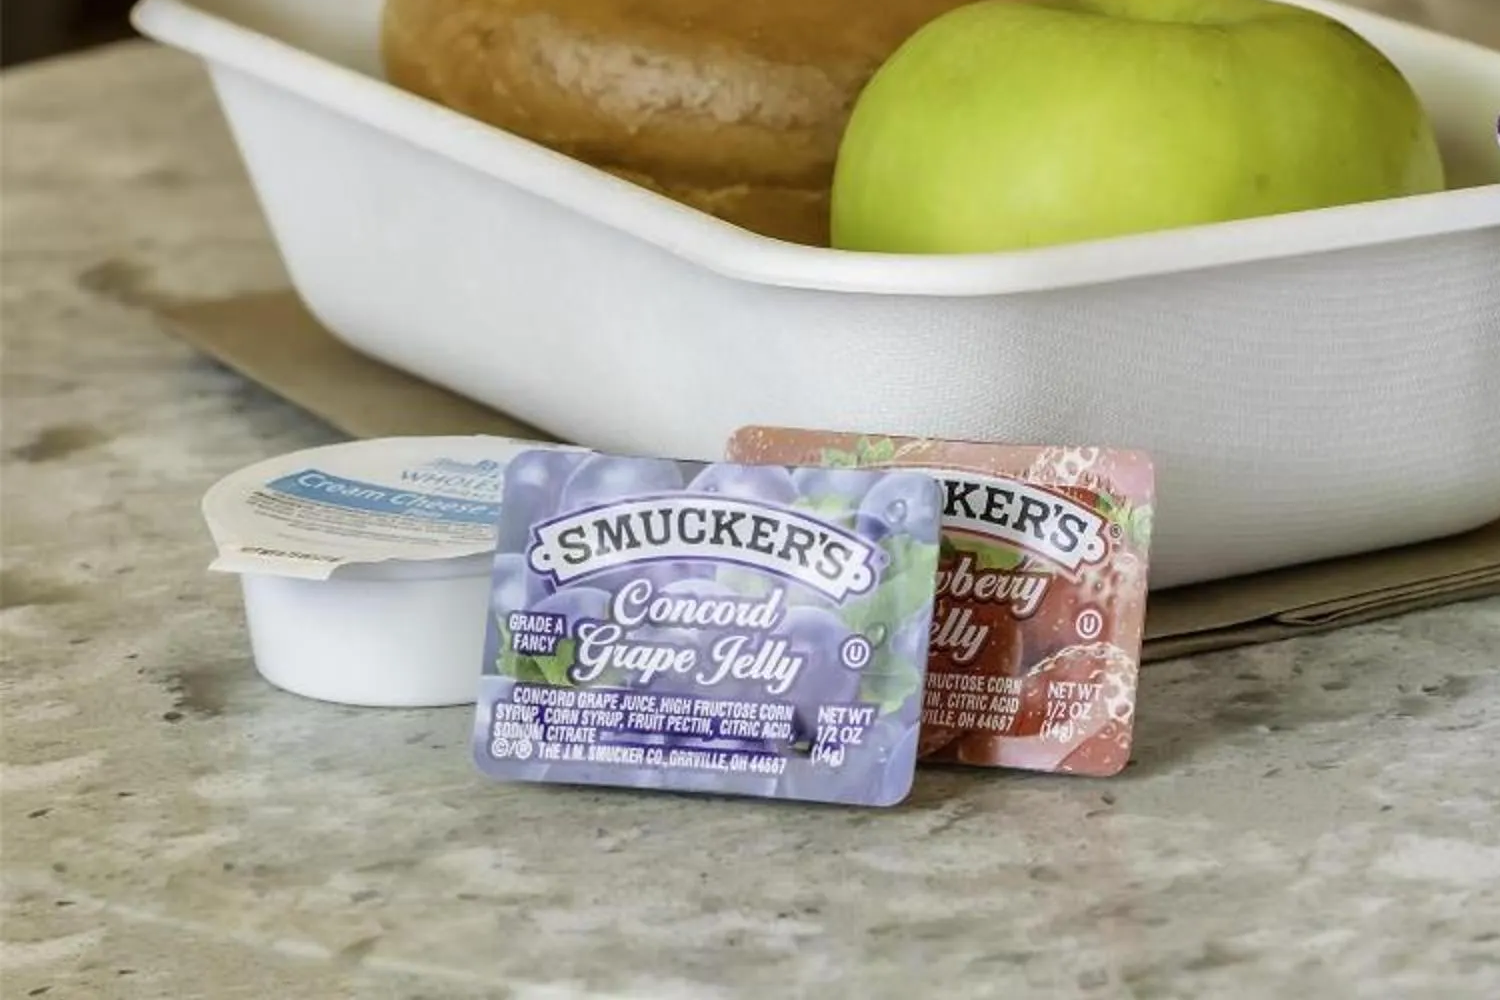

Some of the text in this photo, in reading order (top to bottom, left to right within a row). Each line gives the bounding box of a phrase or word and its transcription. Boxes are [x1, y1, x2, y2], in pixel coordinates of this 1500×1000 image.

[297, 472, 487, 515] Cream Cheese
[936, 479, 1088, 553] KER'S
[557, 507, 855, 580] SMUCKER'S
[935, 557, 1049, 617] berry
[613, 578, 785, 630] Concord
[509, 613, 564, 634] GRADE A
[929, 607, 990, 664] elly
[513, 633, 556, 653] FANCY
[571, 622, 803, 695] Grape Jelly
[927, 673, 1023, 696] RUCTOSE CORN
[1048, 682, 1103, 701] NET WT
[513, 687, 575, 707] CONCORD
[577, 690, 617, 709] GRAPE
[660, 697, 691, 715] HIGH
[693, 699, 757, 720] FRUCTOSE
[759, 704, 795, 721] CORN
[817, 706, 875, 726] NET WT
[947, 694, 987, 712] CITRIC
[989, 697, 1020, 715] ACID
[1046, 701, 1094, 721] 1/2 OZ
[493, 721, 597, 744] SODIUM CITRATE
[495, 703, 795, 741] SYRUP, CORN SYRUP, FRUIT PECTIN, CITRIC ACID,
[958, 713, 974, 728] OH
[817, 726, 864, 746] 1/2 OZ
[538, 742, 561, 760] THE
[589, 745, 644, 765] SMUCKER
[731, 754, 748, 771] OH
